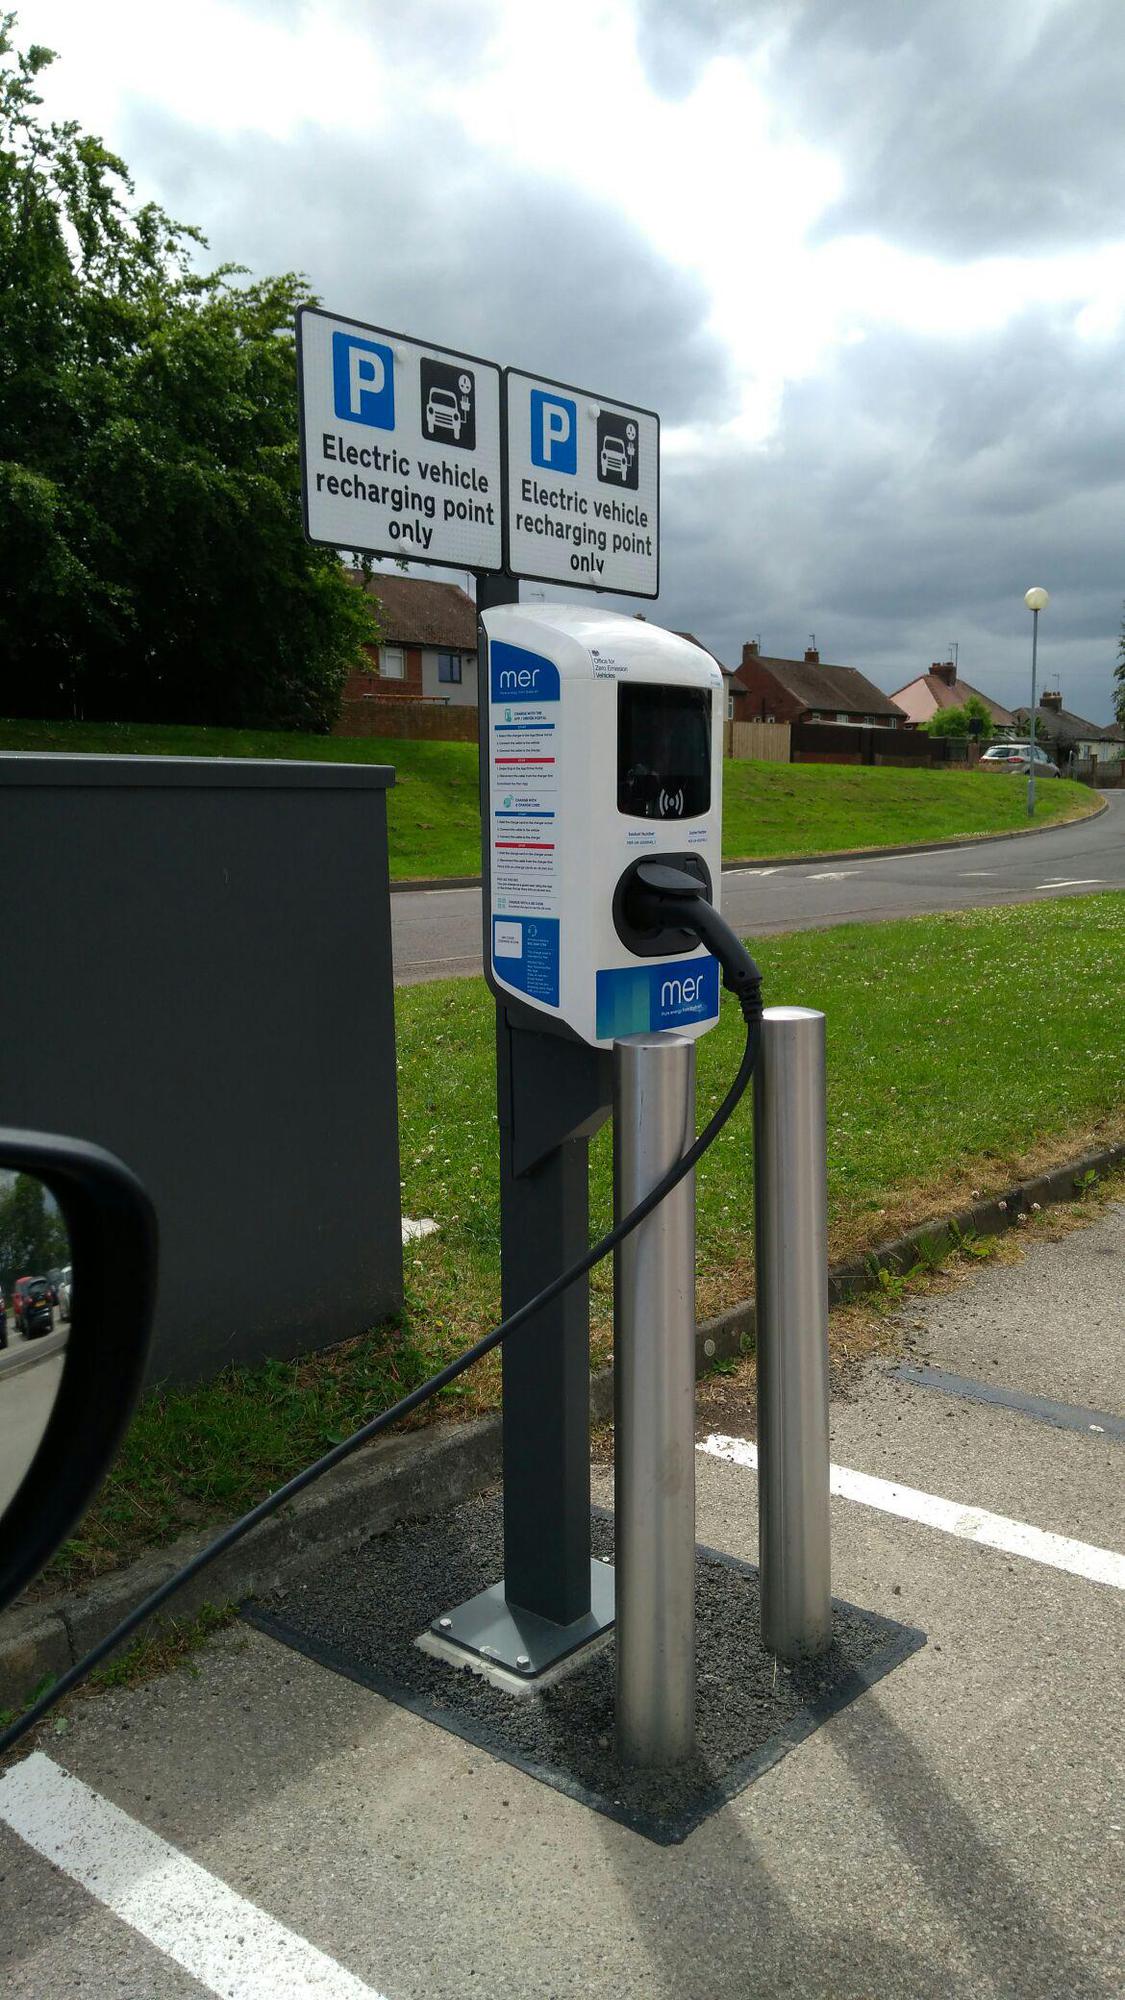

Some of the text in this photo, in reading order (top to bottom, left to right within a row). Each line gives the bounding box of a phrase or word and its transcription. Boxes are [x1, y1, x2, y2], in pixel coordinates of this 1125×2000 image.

[348, 345, 385, 415] P
[542, 400, 570, 462] P
[322, 432, 489, 493] Electric vehicle
[316, 472, 495, 526] recharging point
[521, 478, 648, 528] Electric vehicle
[388, 519, 433, 550] only
[516, 512, 652, 556] recharging point
[570, 552, 605, 575] only
[499, 668, 540, 689] mer
[661, 975, 704, 1007] mer
